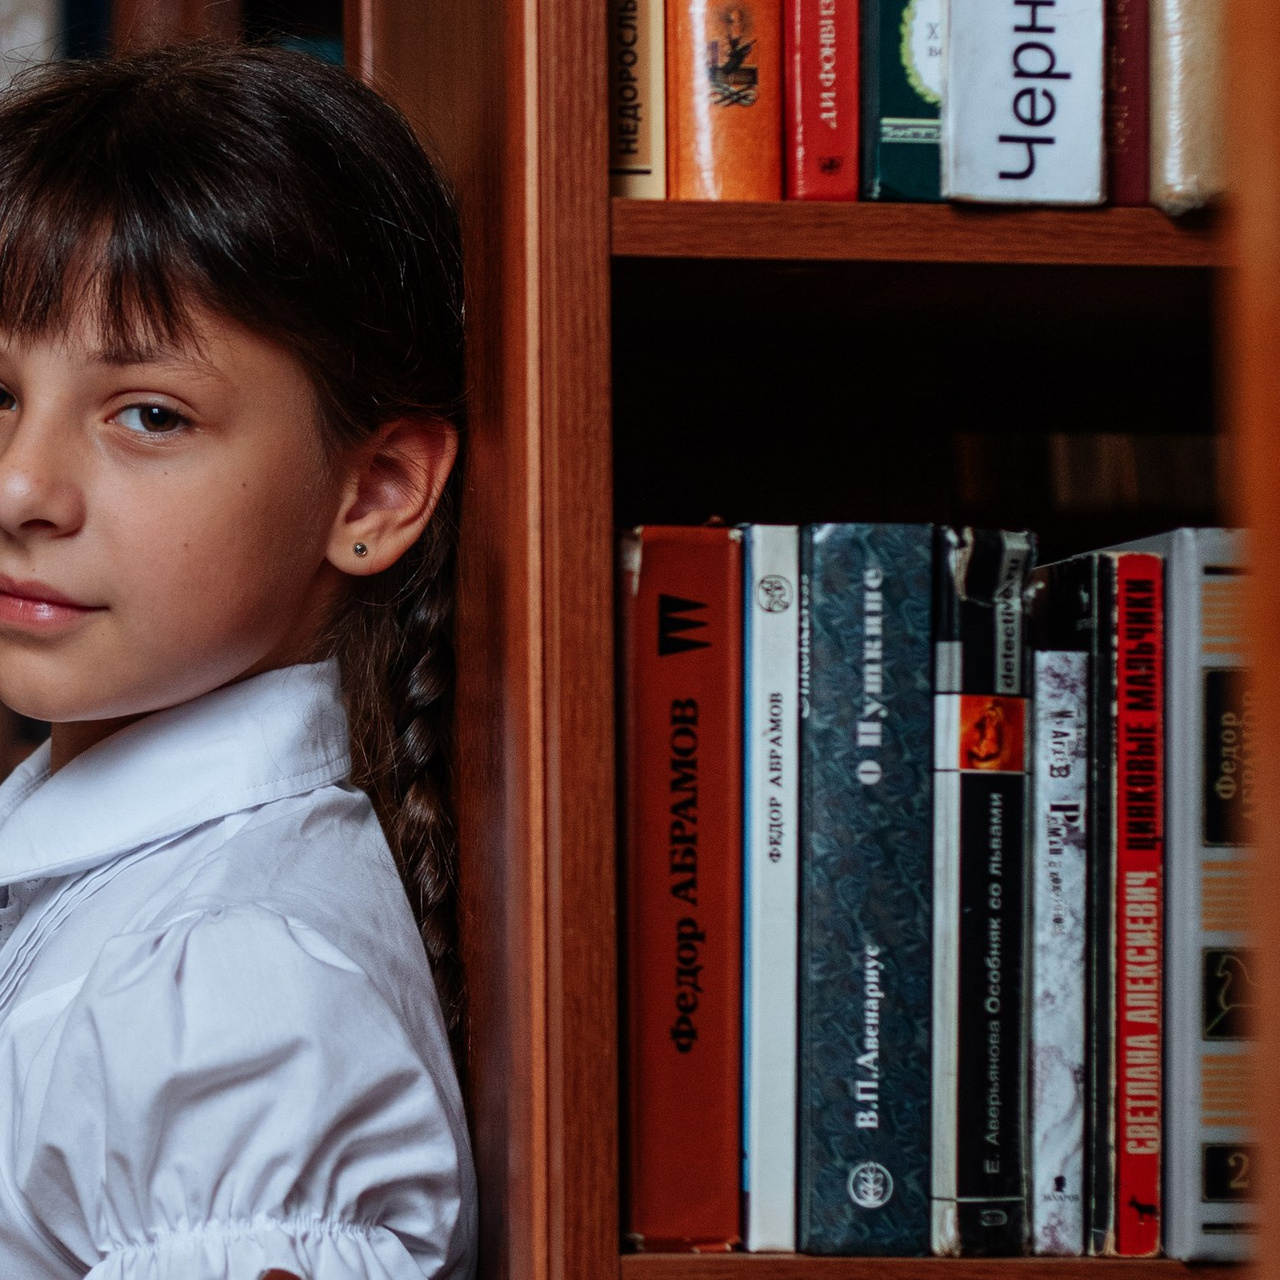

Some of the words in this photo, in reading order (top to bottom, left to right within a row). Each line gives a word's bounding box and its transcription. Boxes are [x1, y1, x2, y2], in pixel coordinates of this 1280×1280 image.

[855, 568, 889, 748] Пушкине
[1124, 578, 1156, 712] МАЛЬЧИКИ
[768, 691, 784, 789] АБРАМОВ
[855, 759, 883, 787] О
[1125, 723, 1162, 852] ЦИНКОВЫЕ
[669, 697, 700, 907] АБРАМОВ
[768, 796, 785, 864] ФЕДОР
[988, 792, 1003, 876] львами
[986, 881, 1002, 911] со
[1124, 869, 1158, 1024] АЛЕКСИЕВИЧ
[671, 917, 707, 1055] Федор
[983, 917, 1002, 1015] Особняк
[984, 1021, 1002, 1147] Аверьянова
[1124, 1034, 1159, 1156] СВЕТЛАНА
[1228, 1151, 1249, 1190] 2
